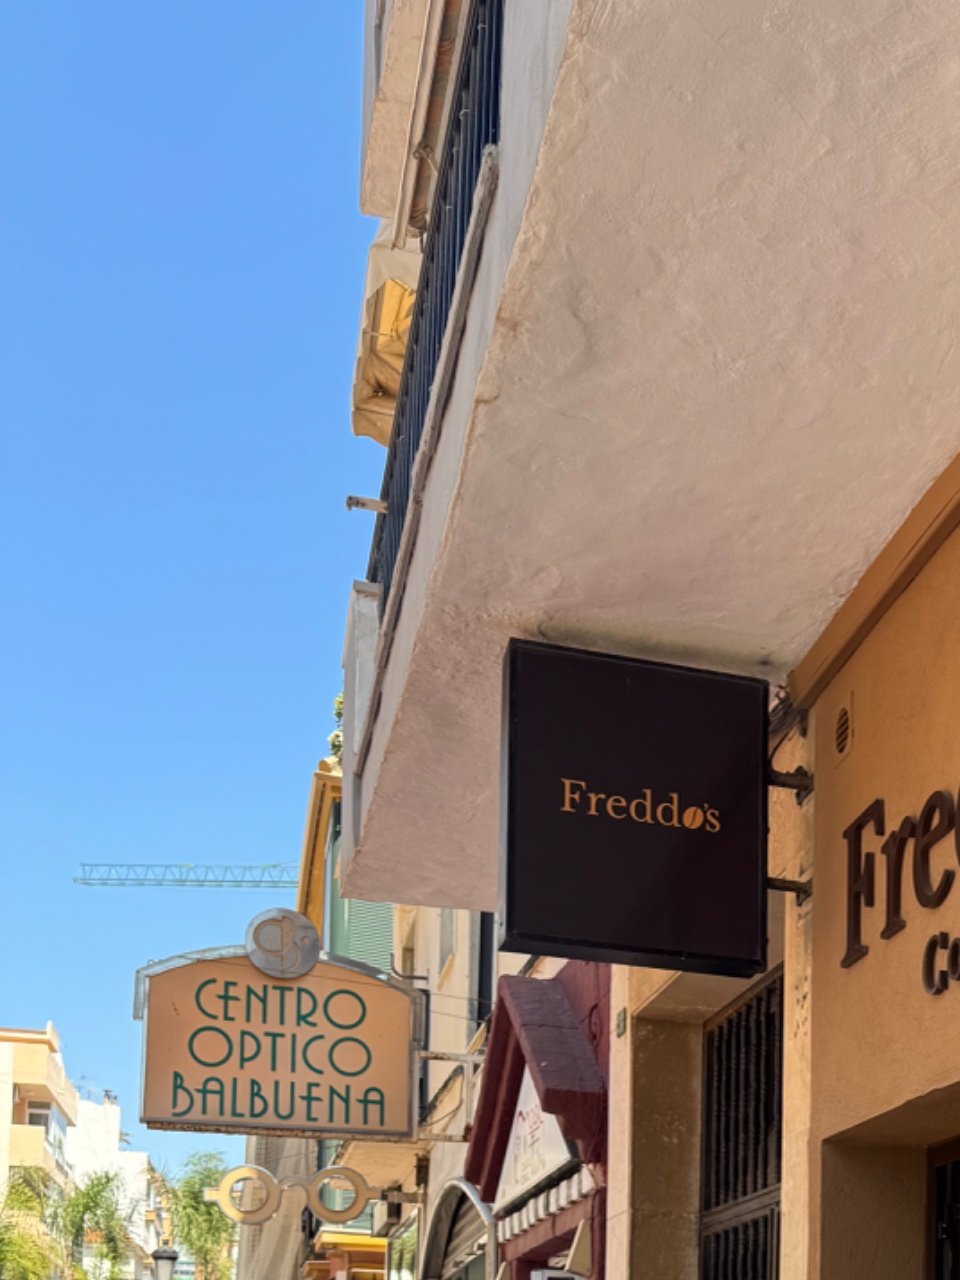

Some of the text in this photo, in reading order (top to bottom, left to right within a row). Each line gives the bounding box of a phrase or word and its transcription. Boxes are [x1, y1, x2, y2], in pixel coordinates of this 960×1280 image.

[560, 778, 721, 832] Freddo's
[195, 978, 367, 1030] CENTRO
[188, 1026, 372, 1077] OPTICO
[172, 1070, 385, 1126] BALBUENA
